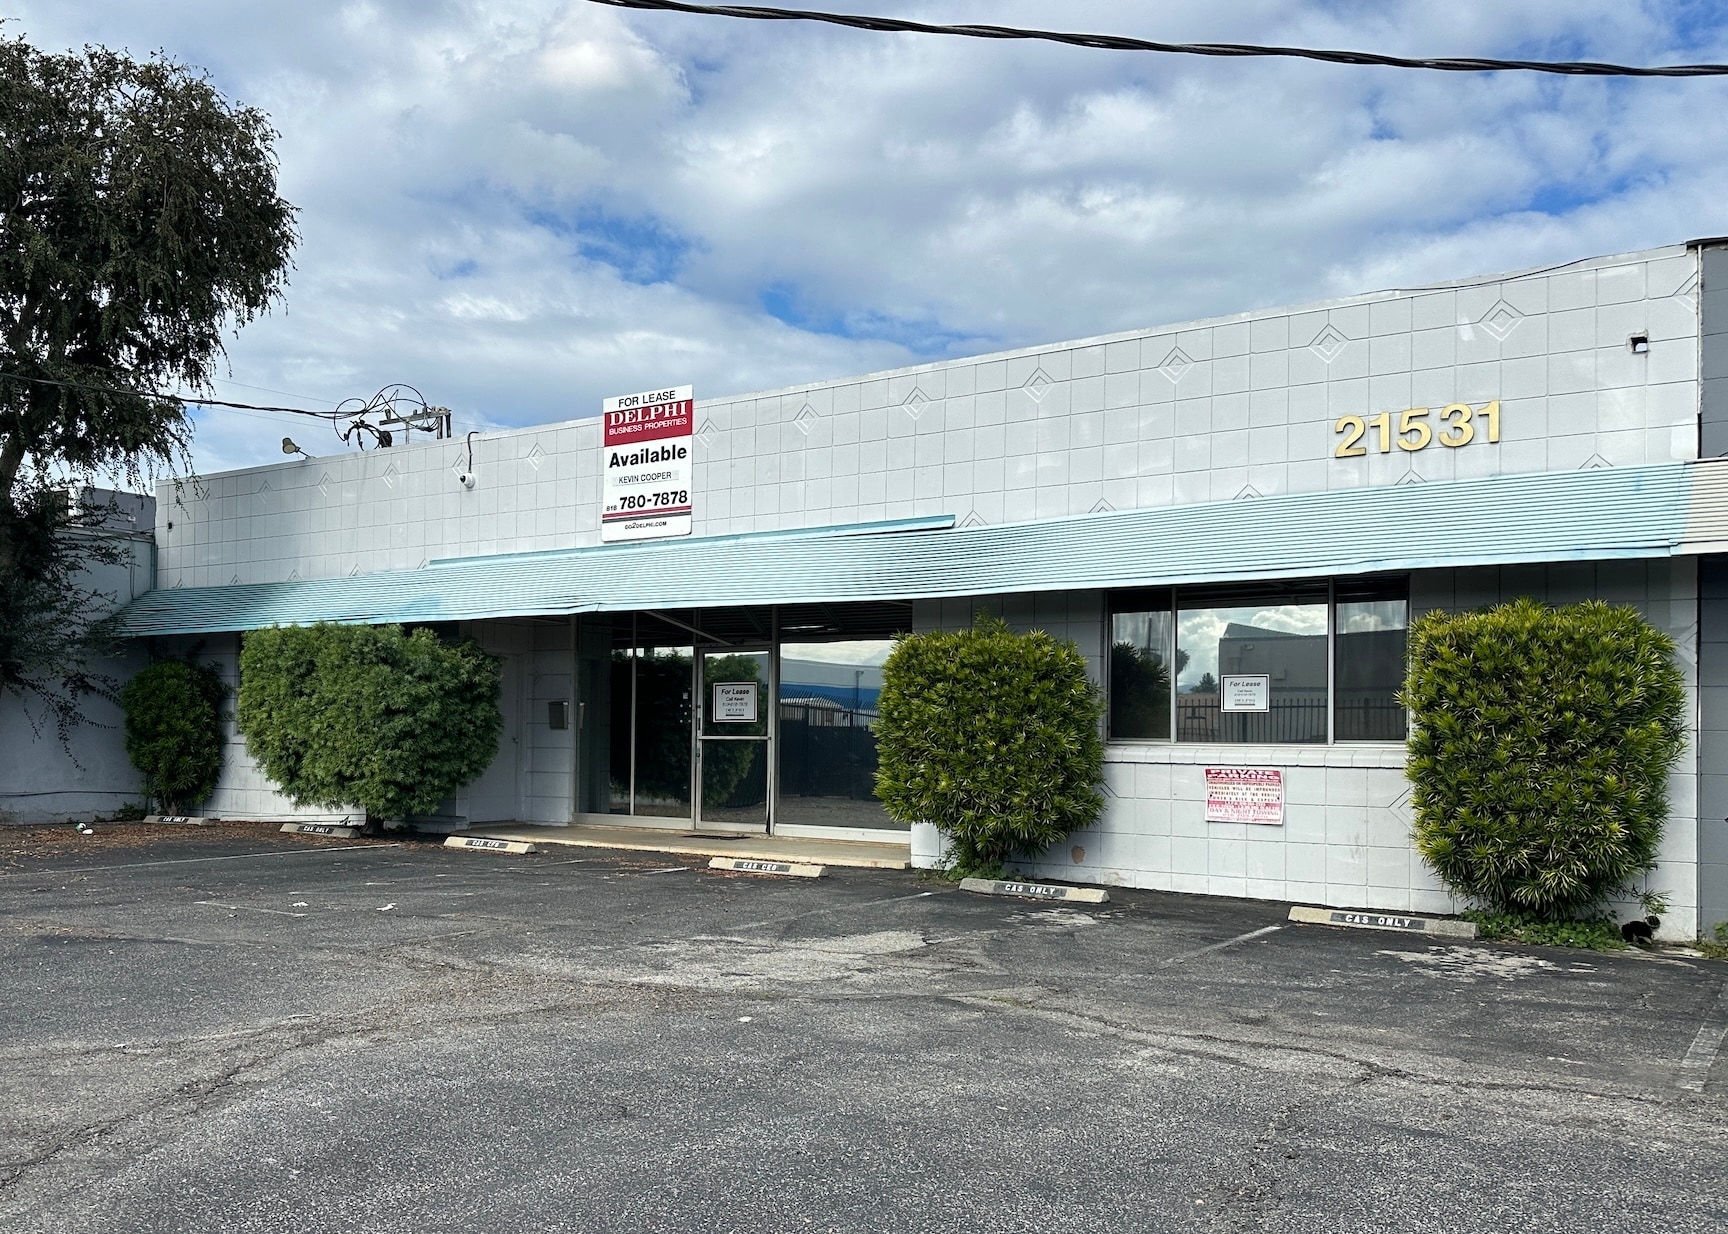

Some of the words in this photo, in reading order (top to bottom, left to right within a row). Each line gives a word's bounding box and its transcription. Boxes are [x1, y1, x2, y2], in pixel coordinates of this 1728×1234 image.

[618, 396, 639, 408] FOR
[642, 390, 676, 404] LEASE
[609, 401, 687, 426] DELPHI
[608, 424, 643, 436] BUSINESS
[644, 417, 688, 430] PROPERTIES
[1335, 399, 1501, 459] 21531
[608, 444, 688, 468] Available
[618, 475, 639, 484] KEVIN
[640, 471, 672, 482] COOPER
[619, 490, 688, 510] 780-7878
[1005, 883, 1024, 892] CAS
[1029, 886, 1056, 895] ONLY
[1345, 914, 1369, 924] CAS
[1377, 917, 1411, 928] ONLY
